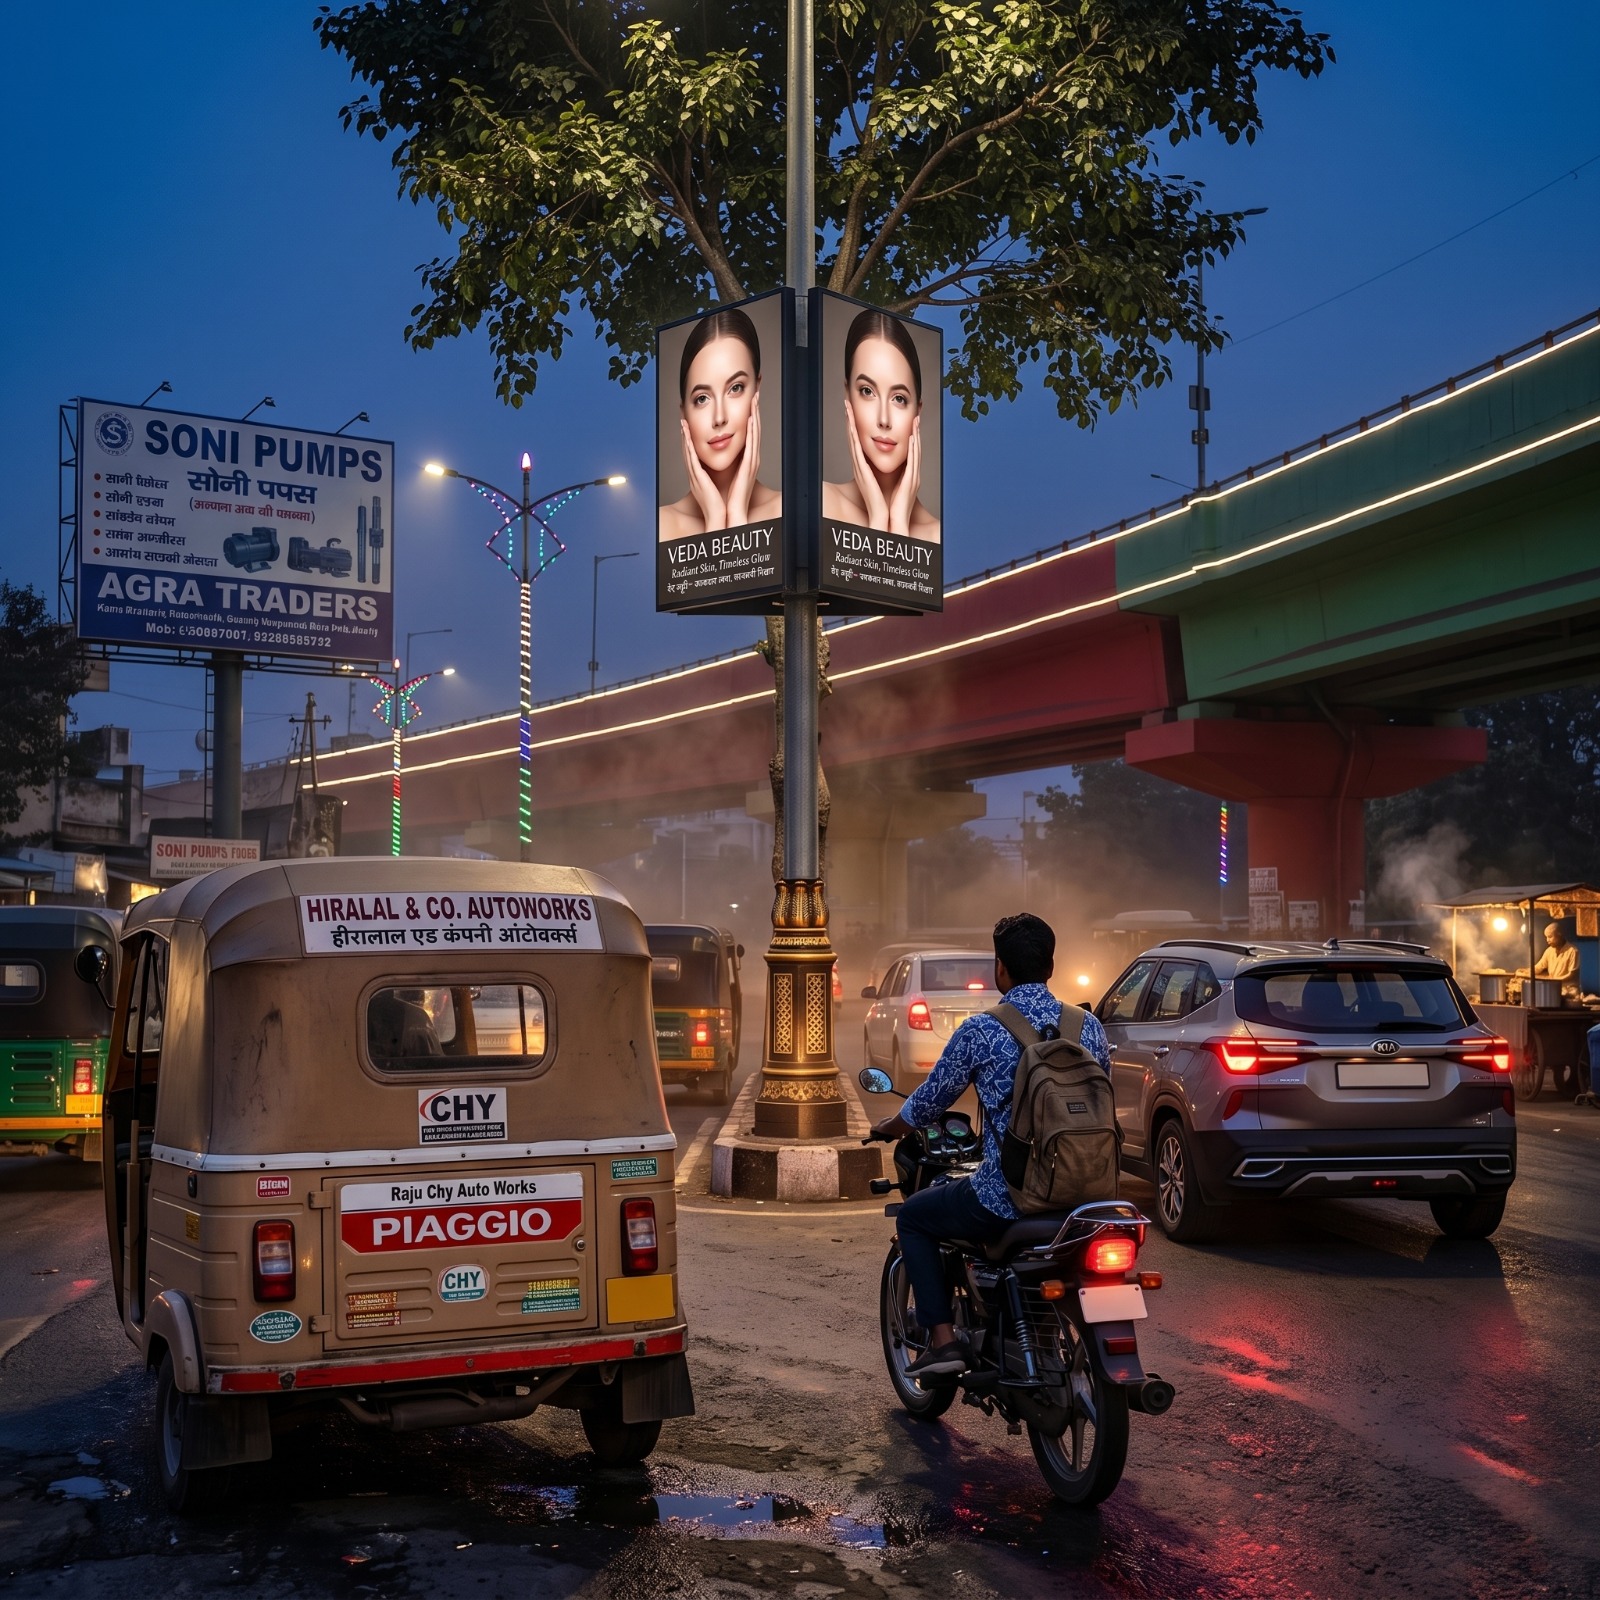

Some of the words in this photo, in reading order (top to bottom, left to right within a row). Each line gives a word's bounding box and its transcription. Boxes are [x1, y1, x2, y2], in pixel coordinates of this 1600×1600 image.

[145, 420, 239, 465] SONI
[254, 434, 383, 483] PUMPS
[187, 466, 251, 496] सोनी
[668, 541, 708, 564] VEDA
[712, 526, 774, 556] BEAUTY
[832, 527, 873, 554] VEDA
[876, 538, 933, 566] BEAUTY
[671, 566, 698, 579] Radiant
[700, 563, 718, 574] Skin,
[863, 558, 881, 572] Skin,
[97, 572, 204, 607] AGRA
[215, 581, 378, 622] TRADERS
[146, 622, 175, 634] Mob:
[156, 843, 186, 858] SONI
[306, 897, 400, 922] HIRALAL
[405, 896, 421, 920] &
[426, 896, 462, 919] CO.
[468, 896, 592, 921] AUTOWORKS
[330, 924, 406, 948] हीरालाल
[410, 929, 439, 946] एड
[442, 922, 493, 943] कंपनी
[1377, 1043, 1396, 1052] KIA
[430, 1093, 497, 1123] CHY
[391, 1186, 423, 1204] Raju
[427, 1184, 453, 1202] Chy
[457, 1182, 490, 1198] Auto
[494, 1180, 537, 1195] Works
[372, 1207, 552, 1246] PIAGGIO
[444, 1271, 481, 1290] CHY
